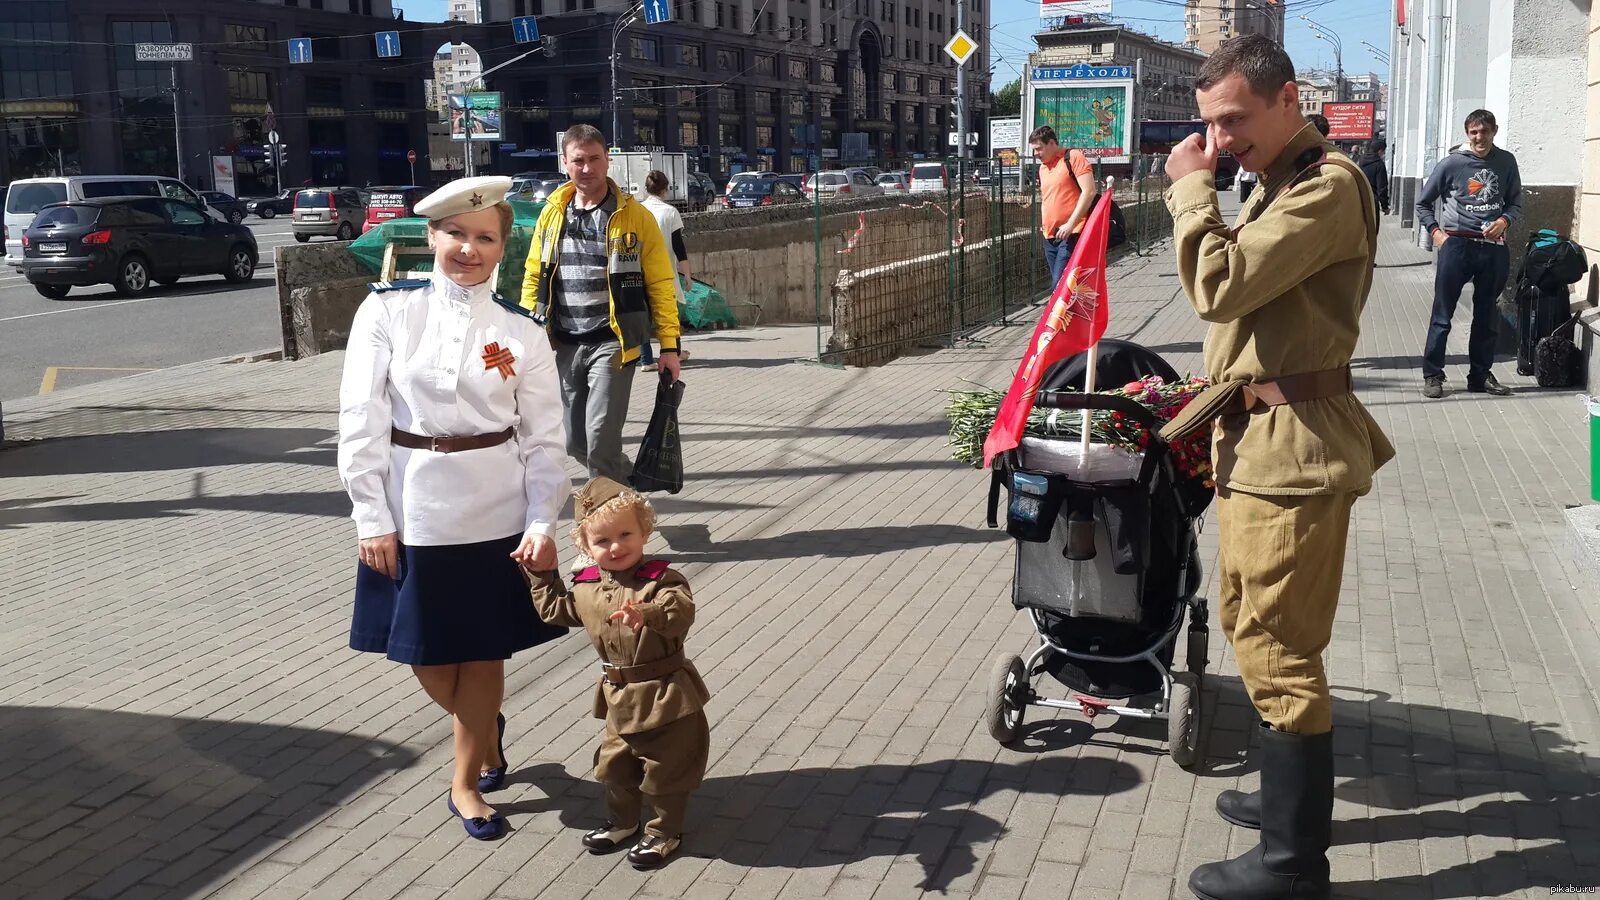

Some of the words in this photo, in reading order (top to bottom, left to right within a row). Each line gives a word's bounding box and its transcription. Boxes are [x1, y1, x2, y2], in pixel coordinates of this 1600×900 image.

[1043, 69, 1119, 78] ПЕРЕХОД
[1465, 203, 1500, 212] Reebok
[618, 254, 638, 262] RAW
